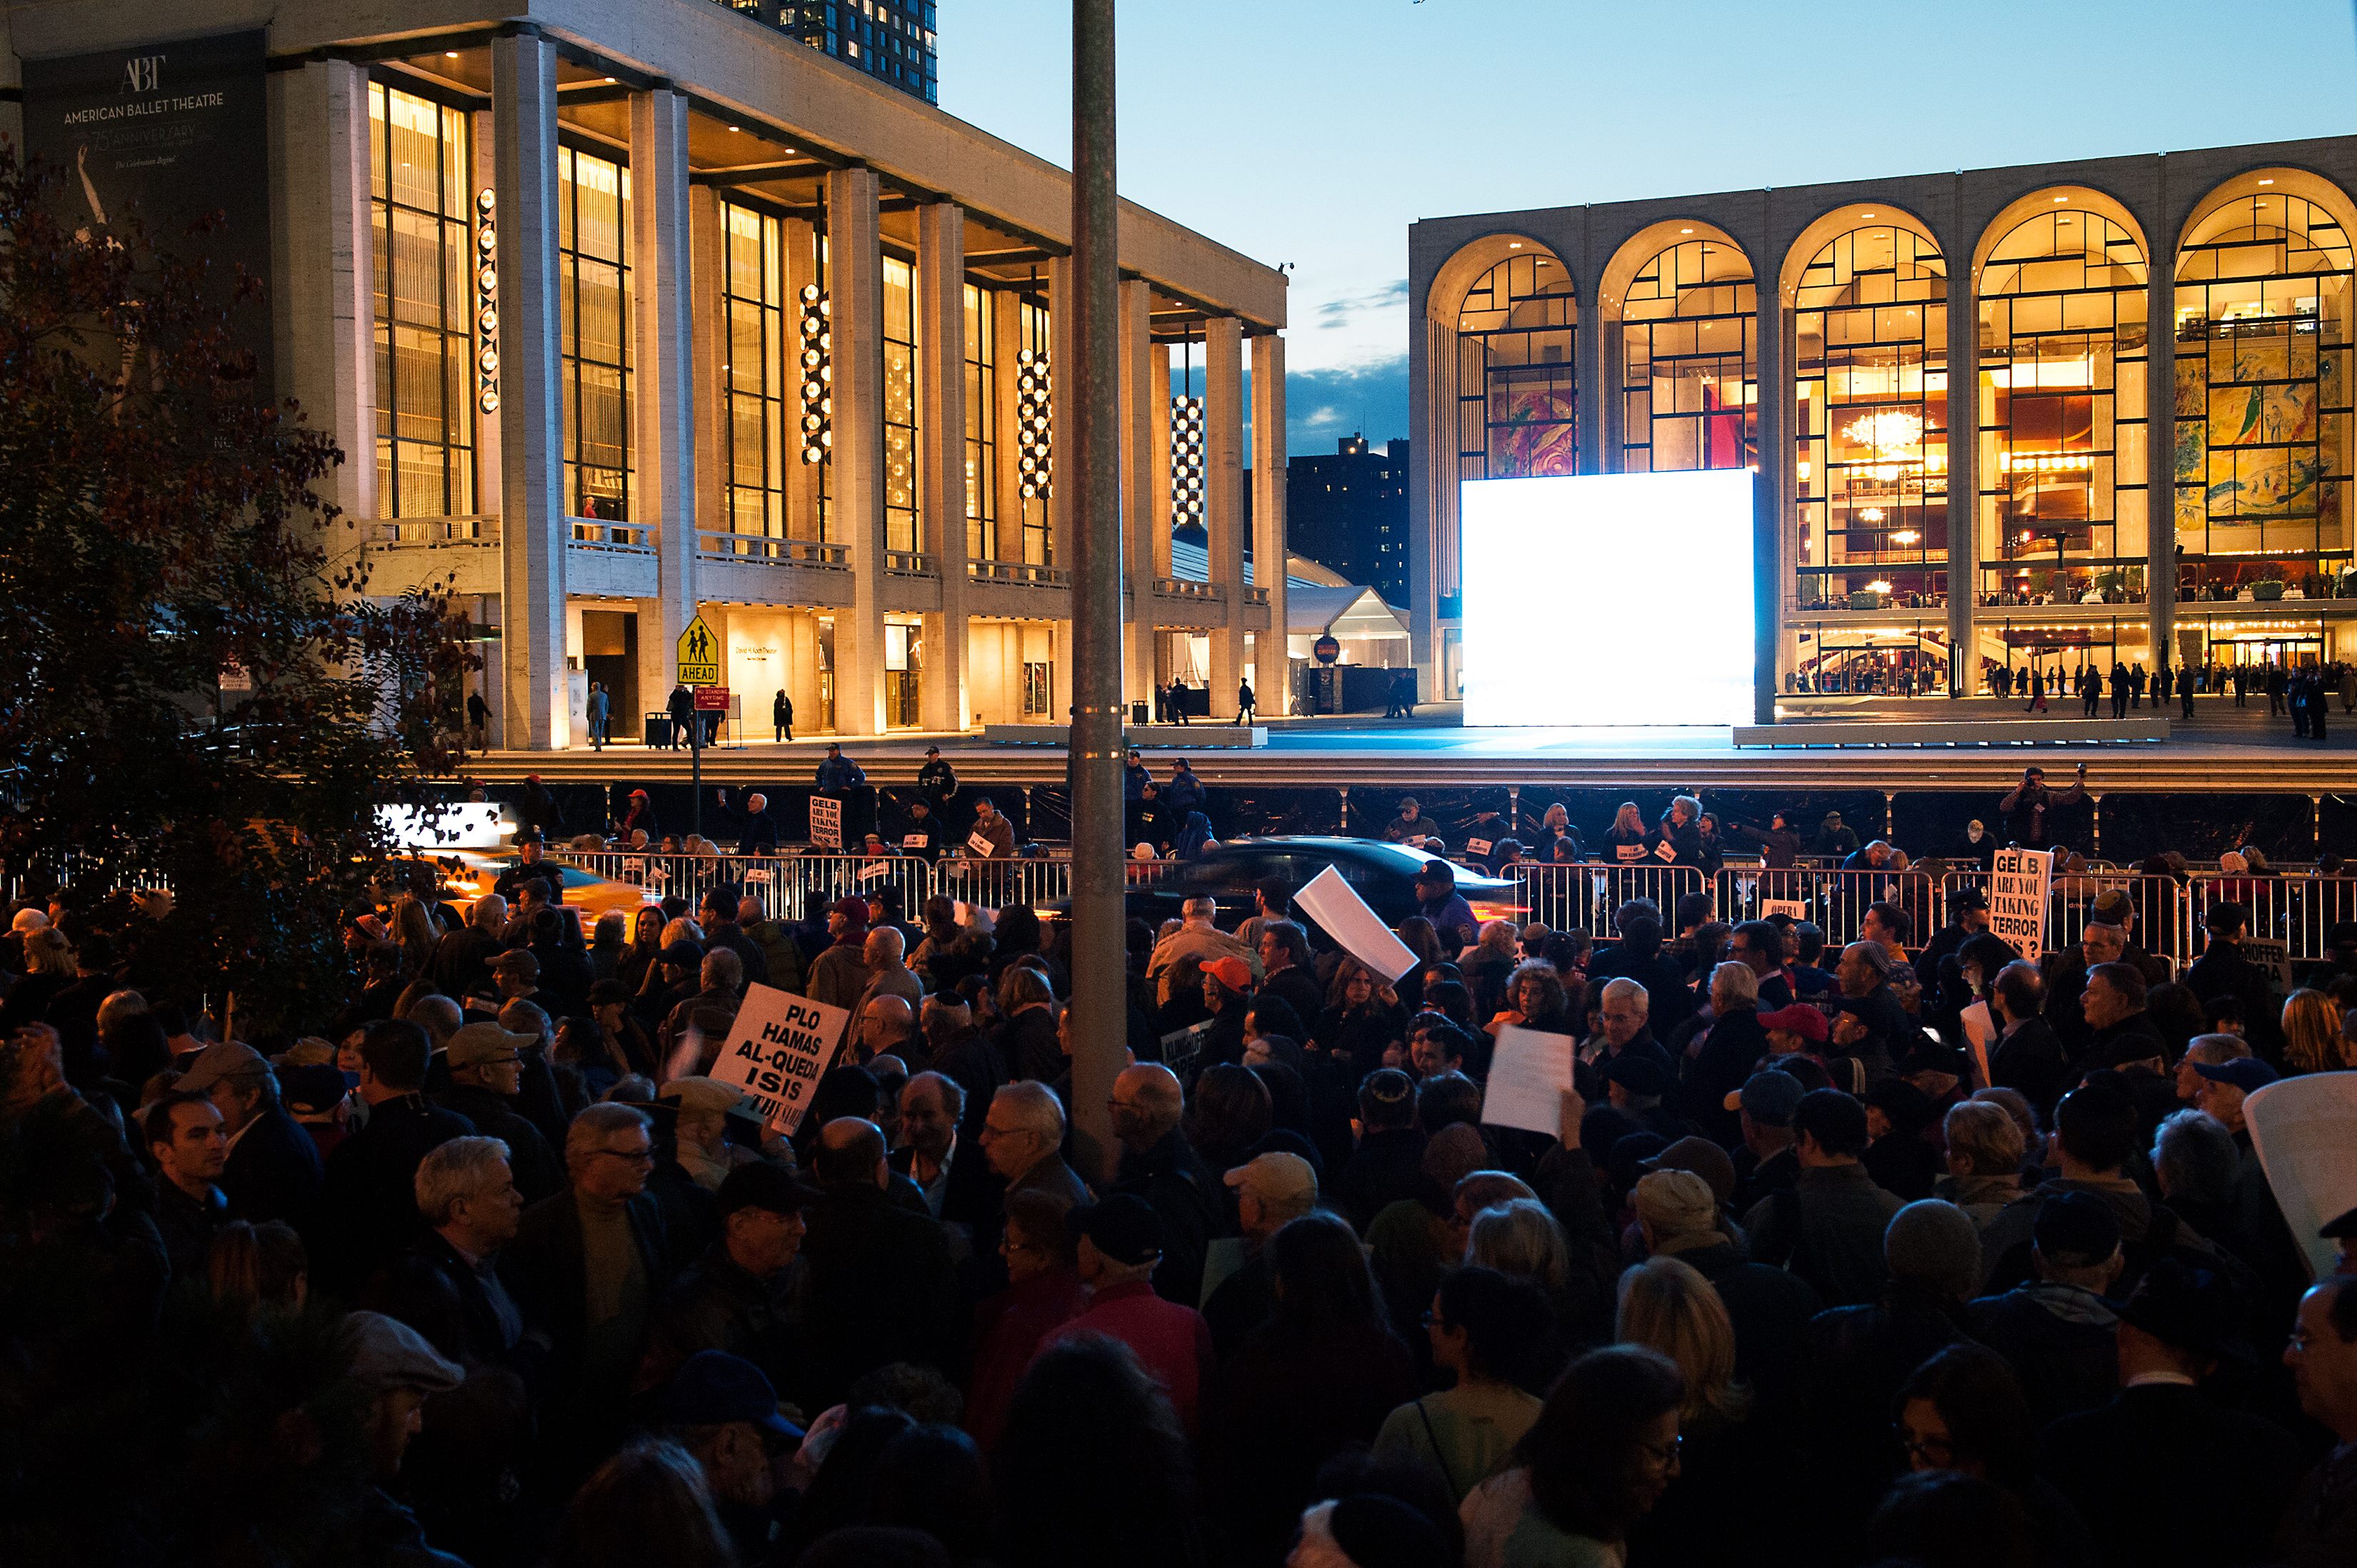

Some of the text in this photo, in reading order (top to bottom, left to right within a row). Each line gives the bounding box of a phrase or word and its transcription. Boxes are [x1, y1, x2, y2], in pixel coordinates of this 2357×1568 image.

[119, 55, 166, 94] ABT
[64, 92, 224, 125] AMERICAN BALLET THEATRE
[682, 667, 714, 679] AHEAD
[812, 808, 837, 819] ARE YOU
[812, 817, 839, 828] TAKING
[812, 825, 839, 837] TERROR
[1996, 855, 2041, 878] GELB,
[1995, 876, 2041, 896] ARE YOU
[1771, 905, 1797, 917] OPERA
[1994, 896, 2039, 916] TAKING
[1993, 916, 2038, 938] TERROR
[786, 1004, 820, 1030] PLO
[761, 1022, 822, 1056] HAMAS
[736, 1040, 820, 1081] AL-QUEDA
[745, 1067, 802, 1100] ISIS
